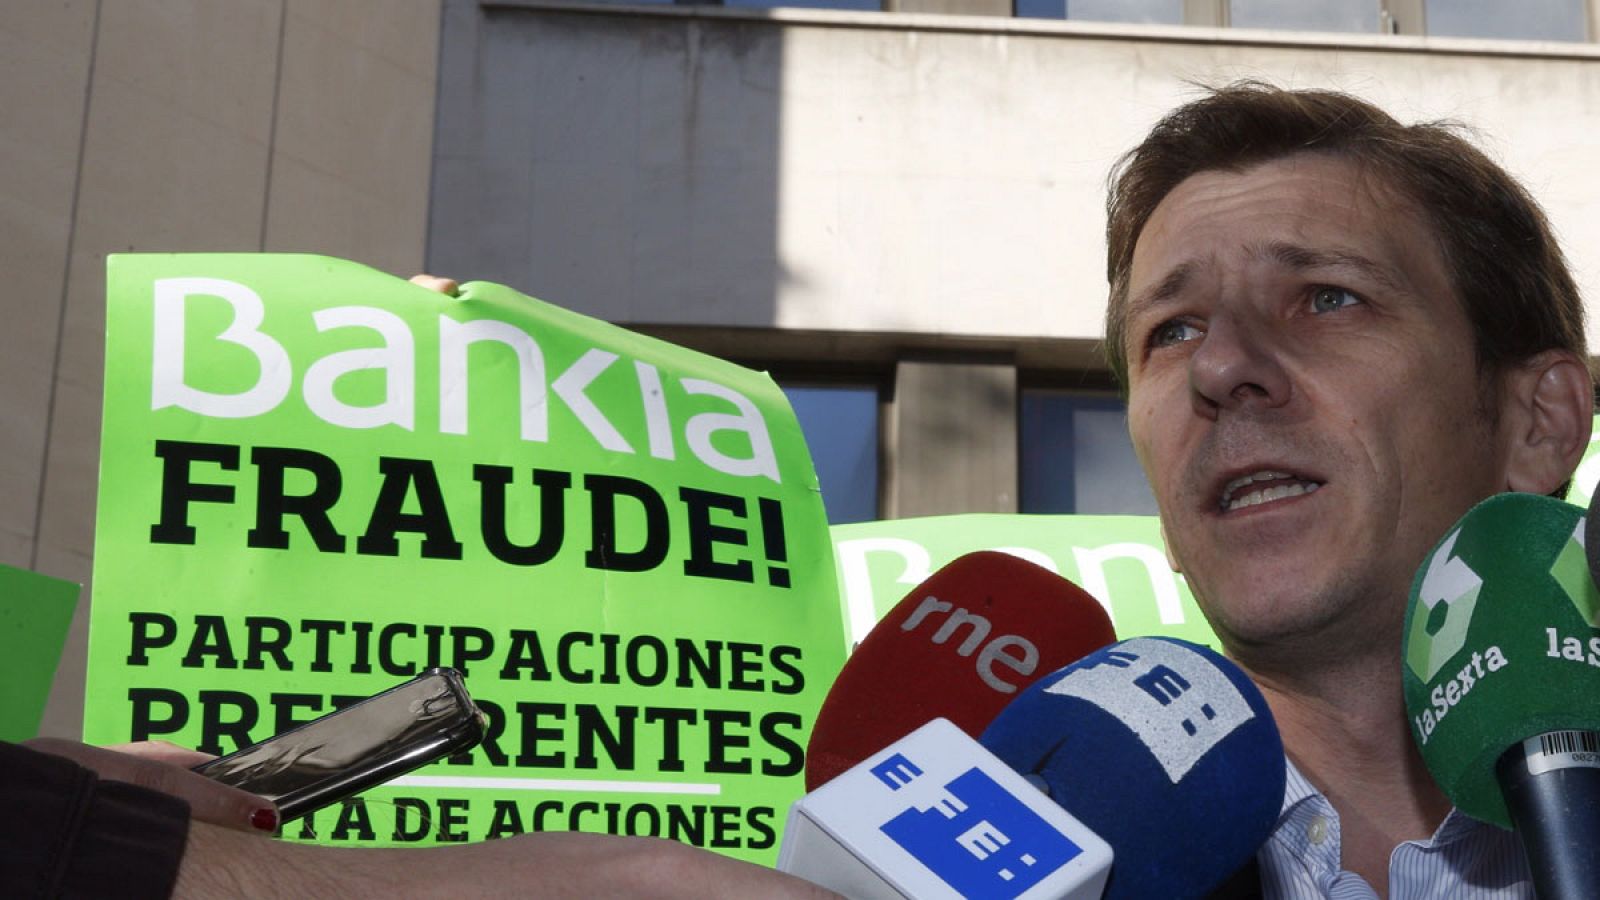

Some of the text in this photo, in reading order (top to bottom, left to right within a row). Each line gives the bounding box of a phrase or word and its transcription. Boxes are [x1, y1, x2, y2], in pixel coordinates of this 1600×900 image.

[151, 276, 782, 483] Bankia
[149, 439, 791, 589] FRAUDE!
[126, 612, 806, 695] PARTICIPACIONES
[900, 595, 1040, 693] rne
[1415, 645, 1508, 745] laSexta
[392, 797, 469, 842] DE
[485, 799, 777, 849] ACCIONES
